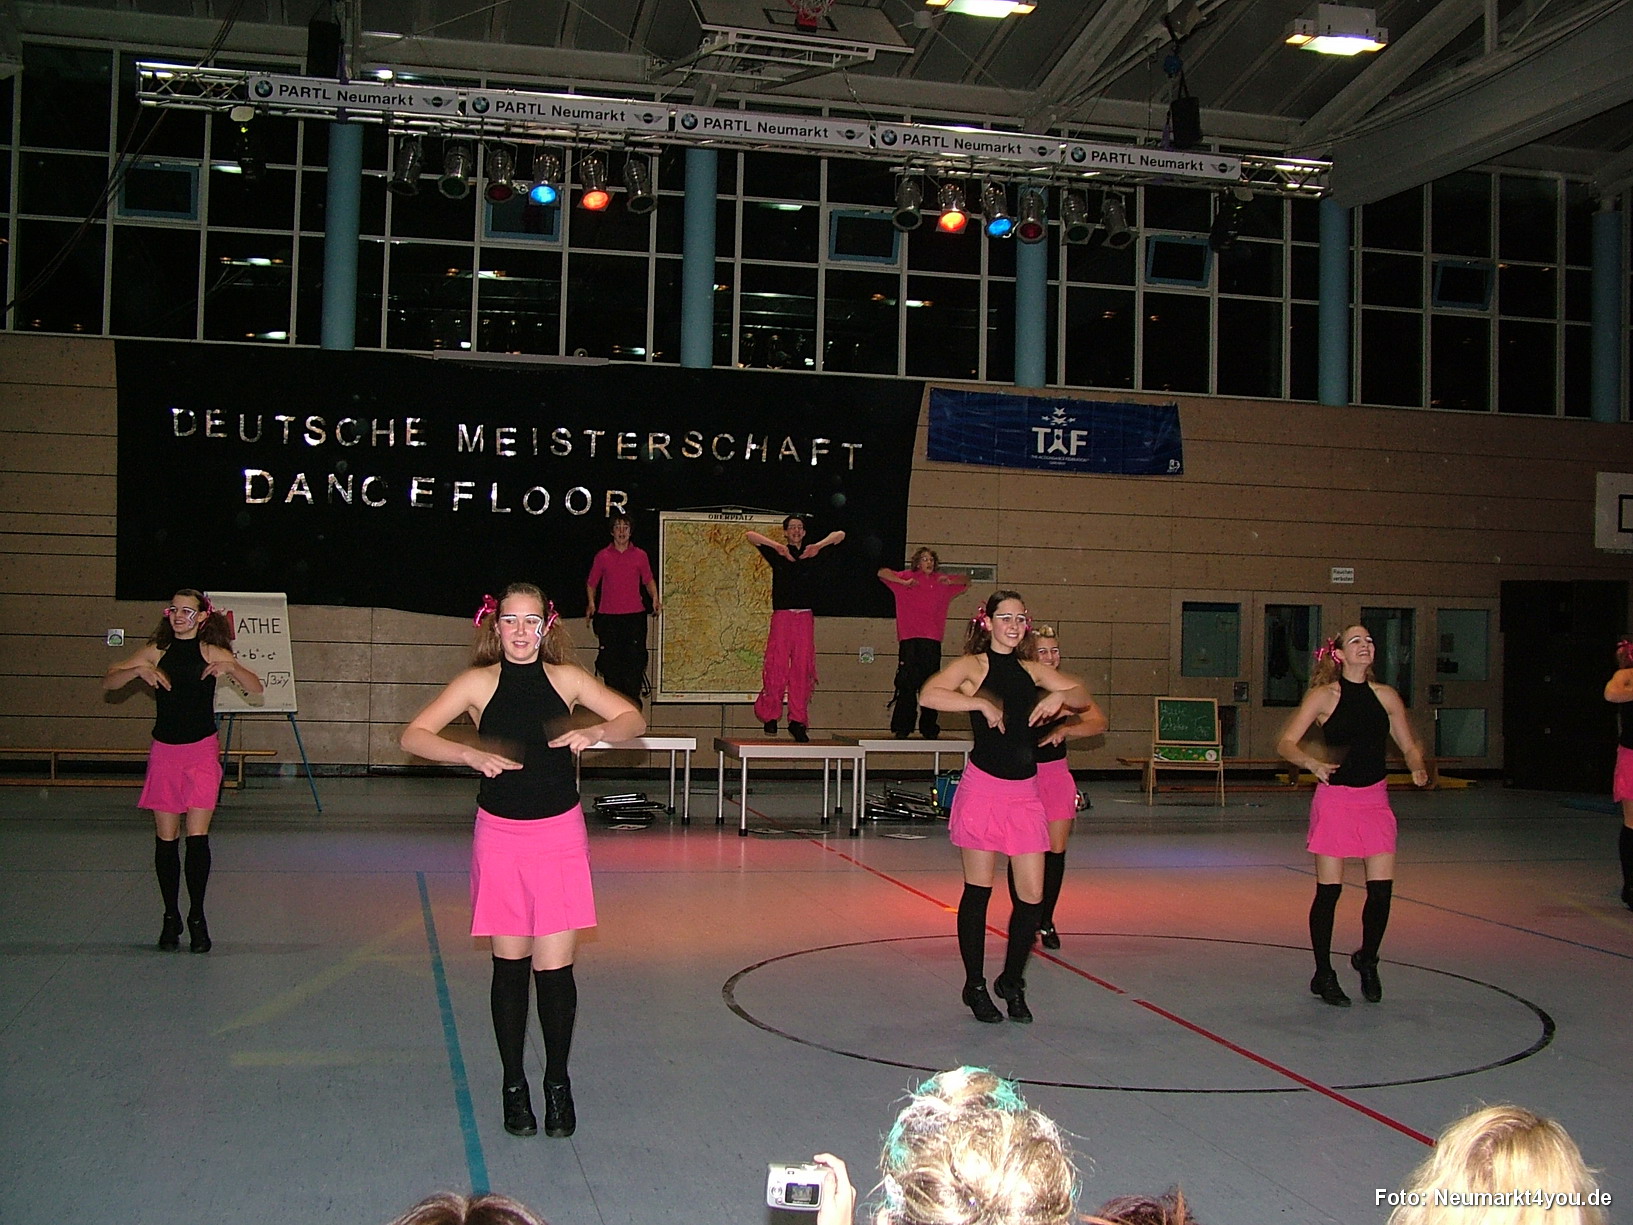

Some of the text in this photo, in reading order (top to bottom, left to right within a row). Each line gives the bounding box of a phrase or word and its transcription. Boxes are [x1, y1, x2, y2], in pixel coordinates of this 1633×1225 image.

[279, 84, 414, 106] PARTL Neumarkt
[495, 101, 625, 122] PARTL Neumarkt
[704, 117, 829, 138] PARTL Neumarkt
[903, 133, 1022, 154] PARTL Neumarkt
[1091, 150, 1204, 171] PARTL Neumarkt
[171, 407, 863, 470] DEUTSCHE MEISTERSCHAFT
